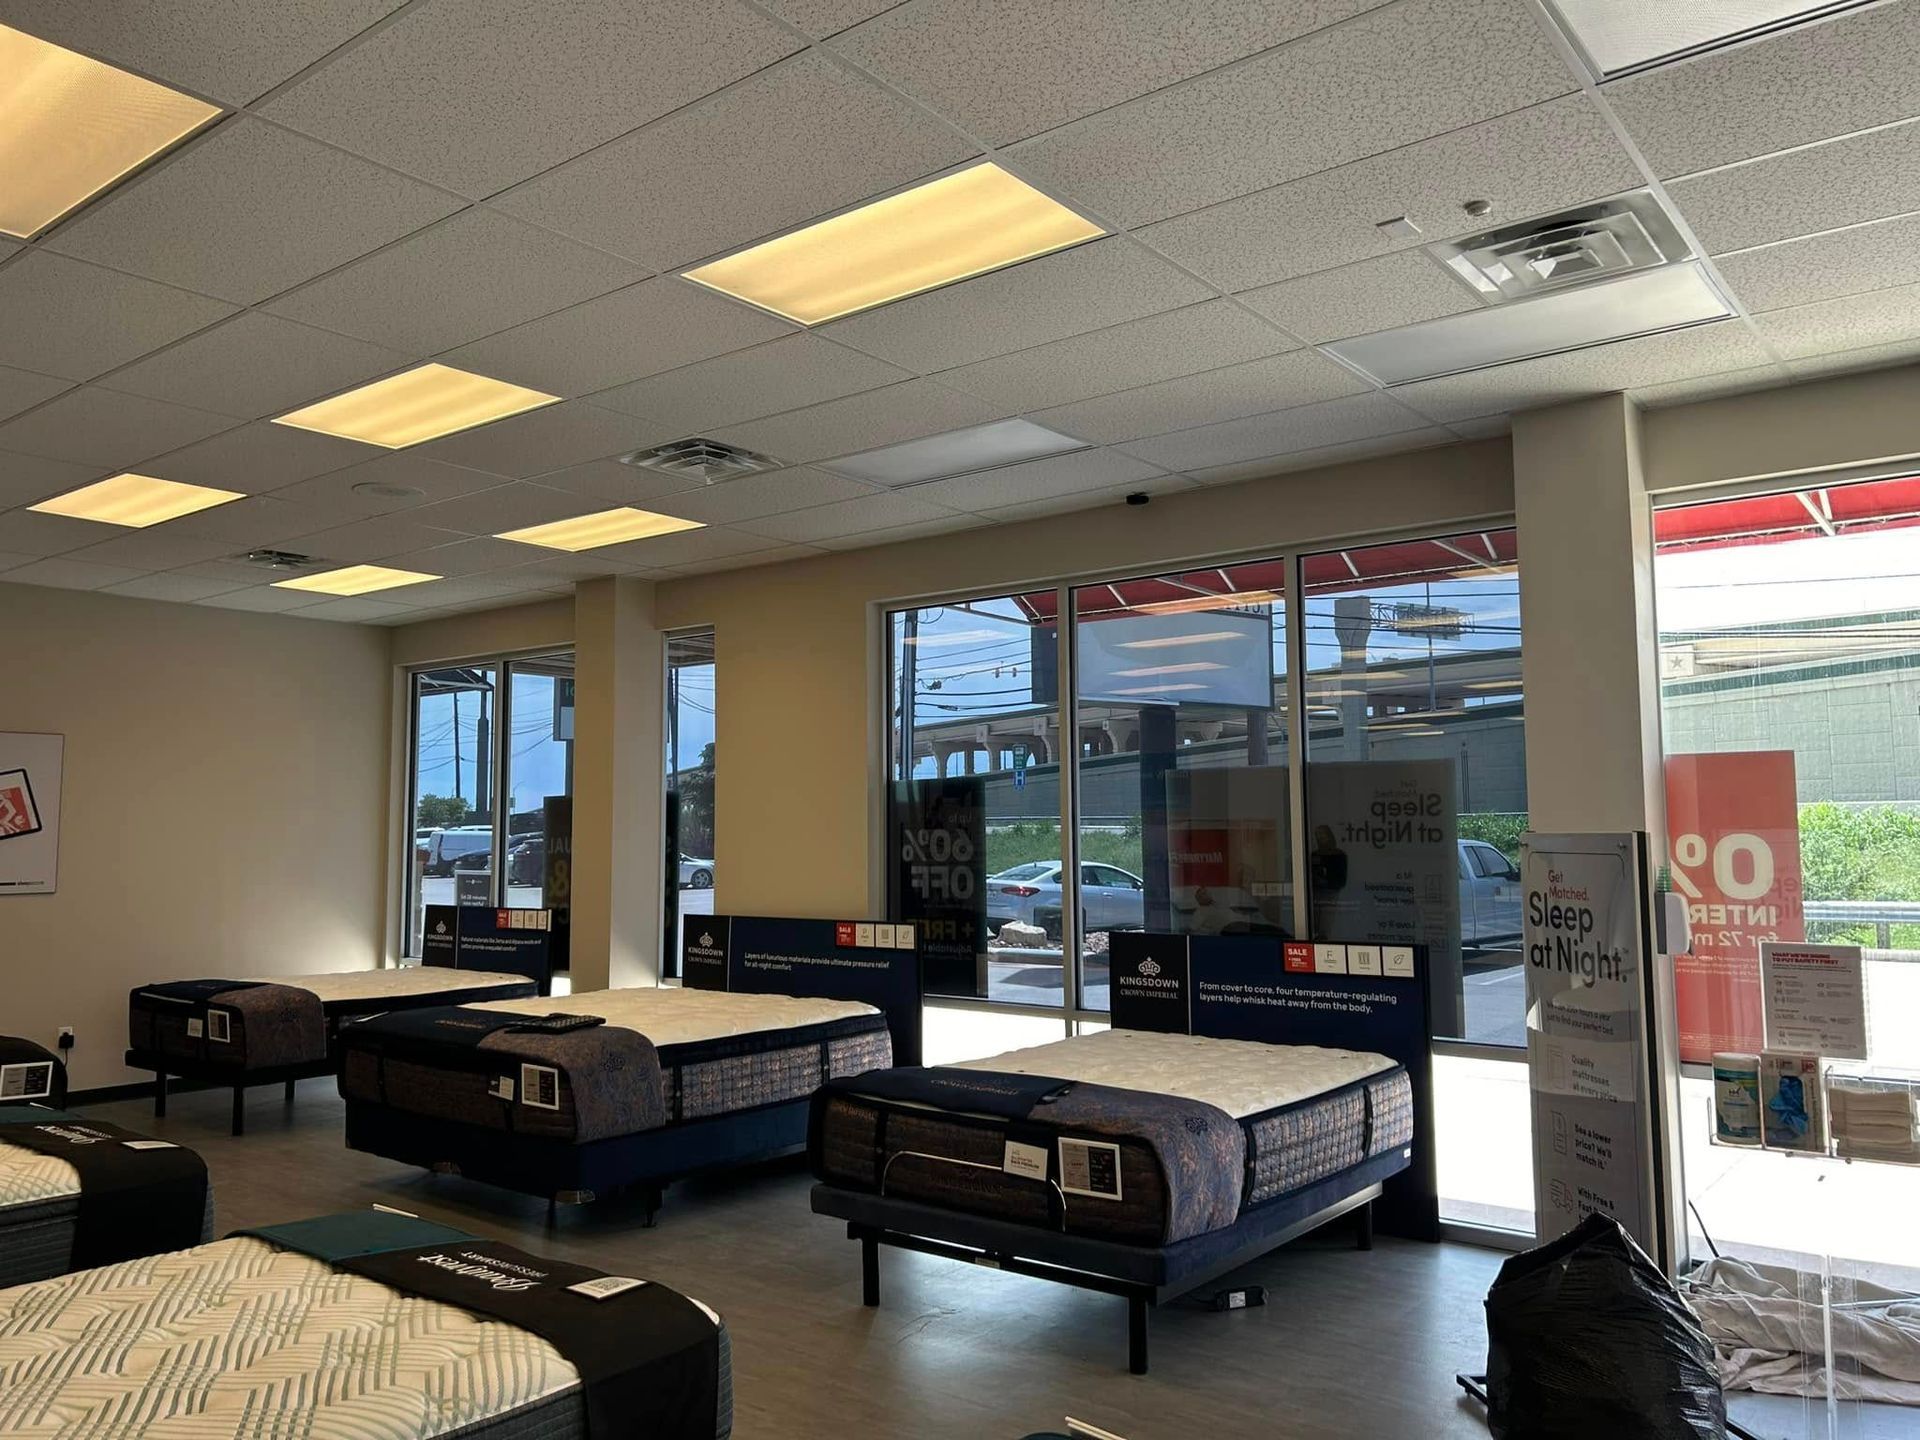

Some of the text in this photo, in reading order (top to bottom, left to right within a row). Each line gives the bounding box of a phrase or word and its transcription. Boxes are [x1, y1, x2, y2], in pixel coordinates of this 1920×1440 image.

[1548, 869, 1564, 883] Get
[1549, 887, 1590, 901] Matched.
[1529, 890, 1594, 943] Sleep
[688, 947, 724, 957] KINGSDOWN
[744, 952, 760, 961] Layers
[1287, 948, 1308, 956] SALE
[1530, 937, 1553, 970] at
[1556, 935, 1628, 989] Night.
[1119, 976, 1179, 988] KINGSDOWN
[1120, 988, 1178, 999] CROWN IMPERIAL
[1200, 982, 1219, 991] From
[1221, 984, 1243, 992] cover
[1244, 984, 1253, 992] to
[1276, 986, 1294, 995] four
[1295, 987, 1397, 1005] temperature-regulating
[1200, 992, 1373, 1014] layers help whisk heat away from the body.
[1571, 1054, 1595, 1069] Quality
[1574, 1122, 1587, 1136] See
[1592, 1129, 1612, 1145] lower
[1575, 1138, 1596, 1153] price?
[1575, 1152, 1597, 1168] match
[1578, 1186, 1592, 1201] With
[1593, 1192, 1609, 1208] Free
[1578, 1199, 1593, 1215] Fast
[416, 1253, 542, 1291] Beautyrest
